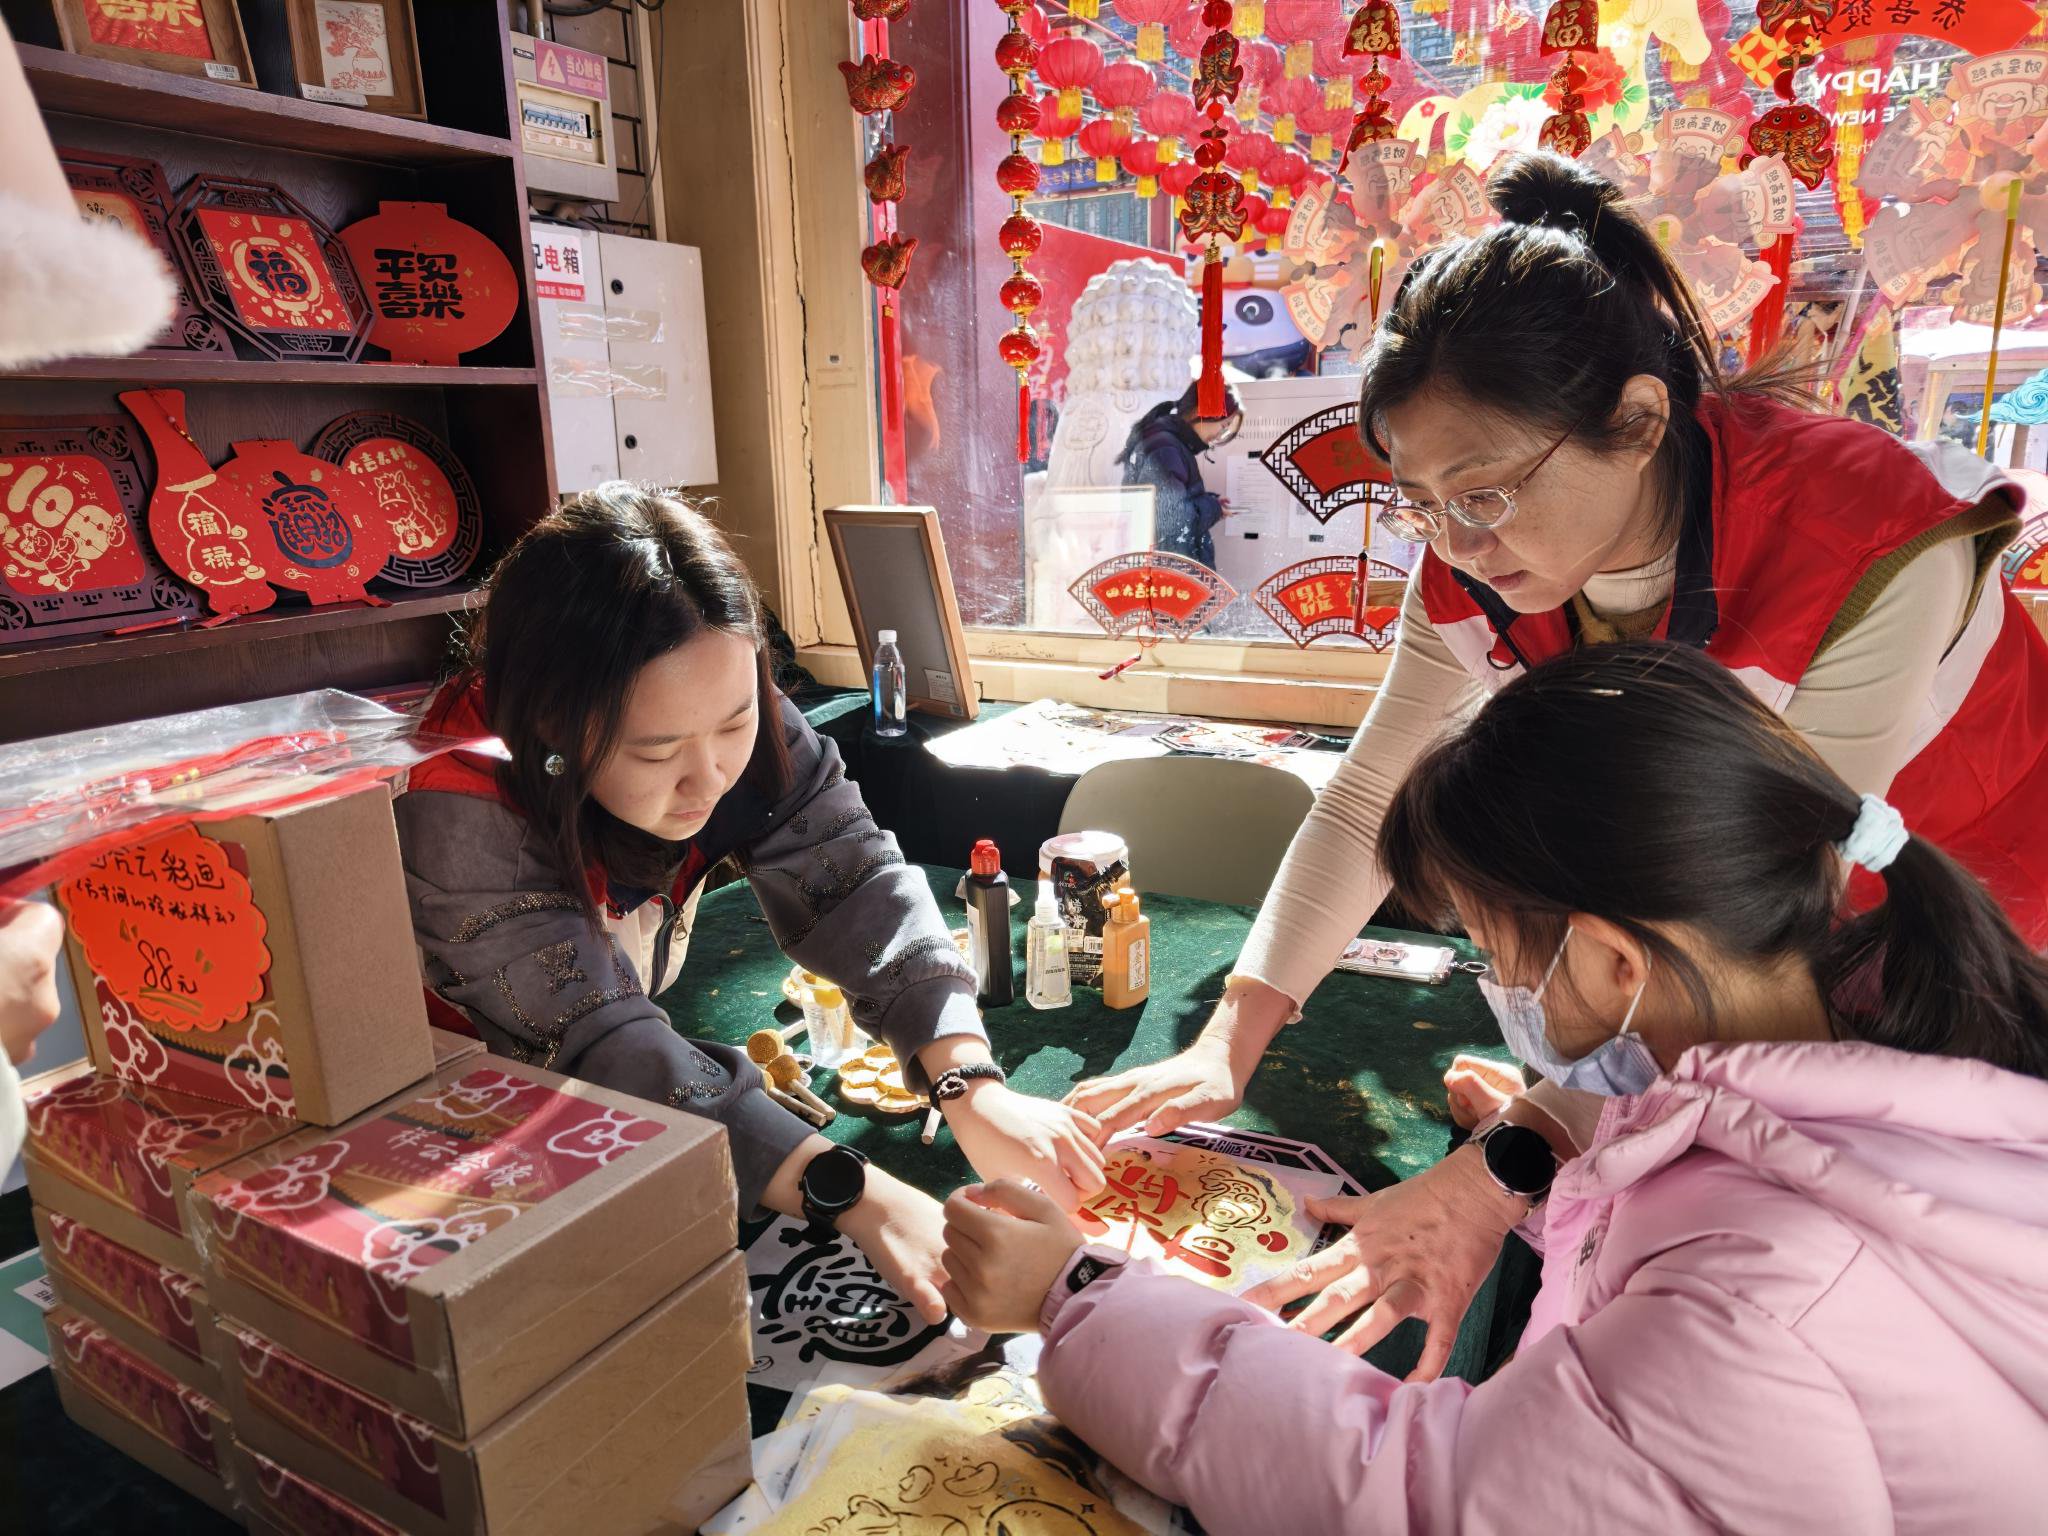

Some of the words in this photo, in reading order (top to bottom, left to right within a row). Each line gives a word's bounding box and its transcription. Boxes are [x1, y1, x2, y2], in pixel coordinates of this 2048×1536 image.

[1352, 20, 1390, 52] 福
[1545, 11, 1583, 47] 福
[249, 249, 308, 295] 福
[374, 248, 459, 283] 平安
